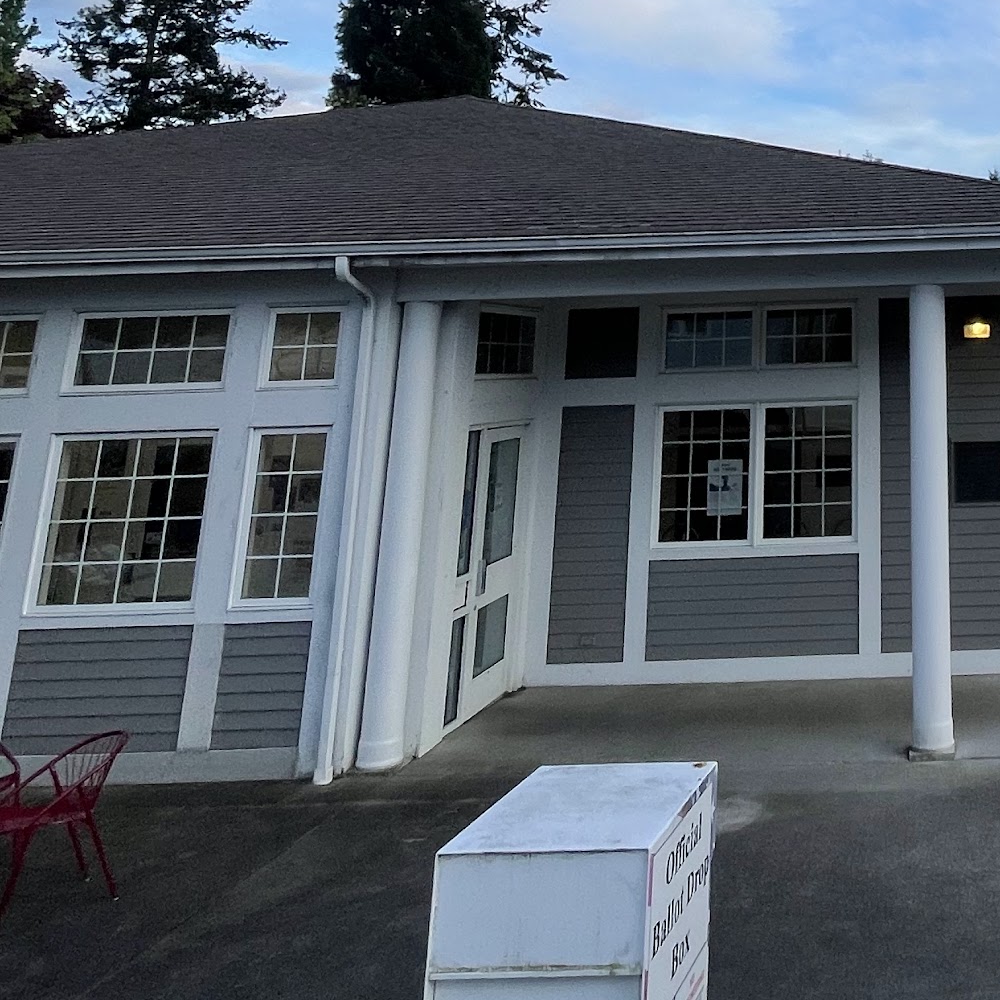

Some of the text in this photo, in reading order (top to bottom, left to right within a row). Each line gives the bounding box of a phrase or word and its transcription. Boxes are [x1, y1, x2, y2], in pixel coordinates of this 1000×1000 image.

[665, 811, 702, 884] Official
[651, 854, 709, 960] Ballot Drop
[670, 929, 690, 980] Box
